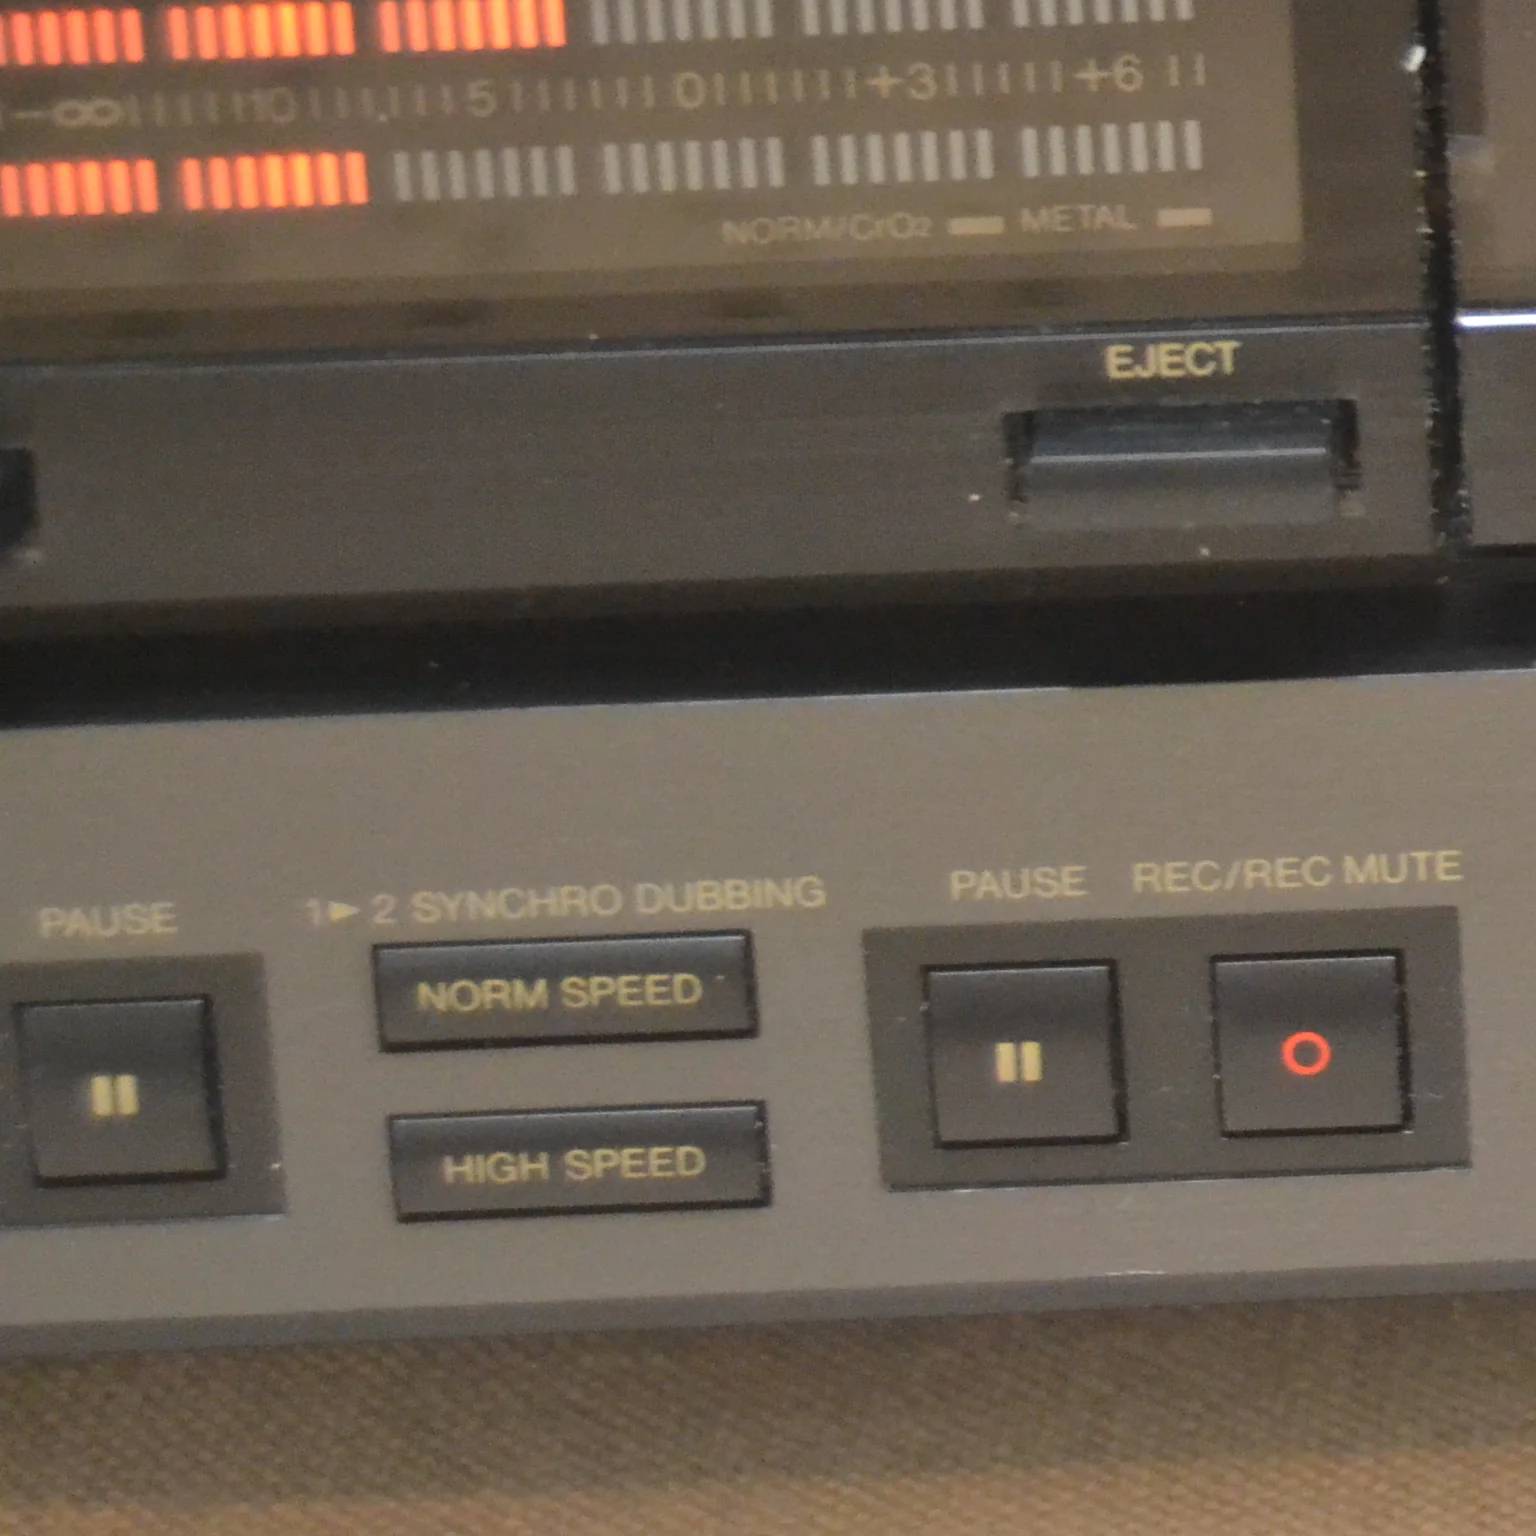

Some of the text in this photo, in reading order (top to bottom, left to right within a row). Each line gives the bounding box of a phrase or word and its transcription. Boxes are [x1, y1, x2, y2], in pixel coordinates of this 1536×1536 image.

[871, 62, 938, 102] +3
[1073, 52, 1145, 94] +6
[1020, 202, 1138, 234] METAL
[1105, 340, 1242, 380] EJECT
[949, 849, 1464, 902] PAUSE REC/REC MUTE
[373, 895, 397, 925] 2
[412, 884, 624, 925] SYNCHRO
[635, 875, 828, 916] DUBBING
[40, 901, 179, 940] PAUSE
[417, 973, 703, 1012] NORM SPEED
[443, 1145, 706, 1185] HIGH SPEED
